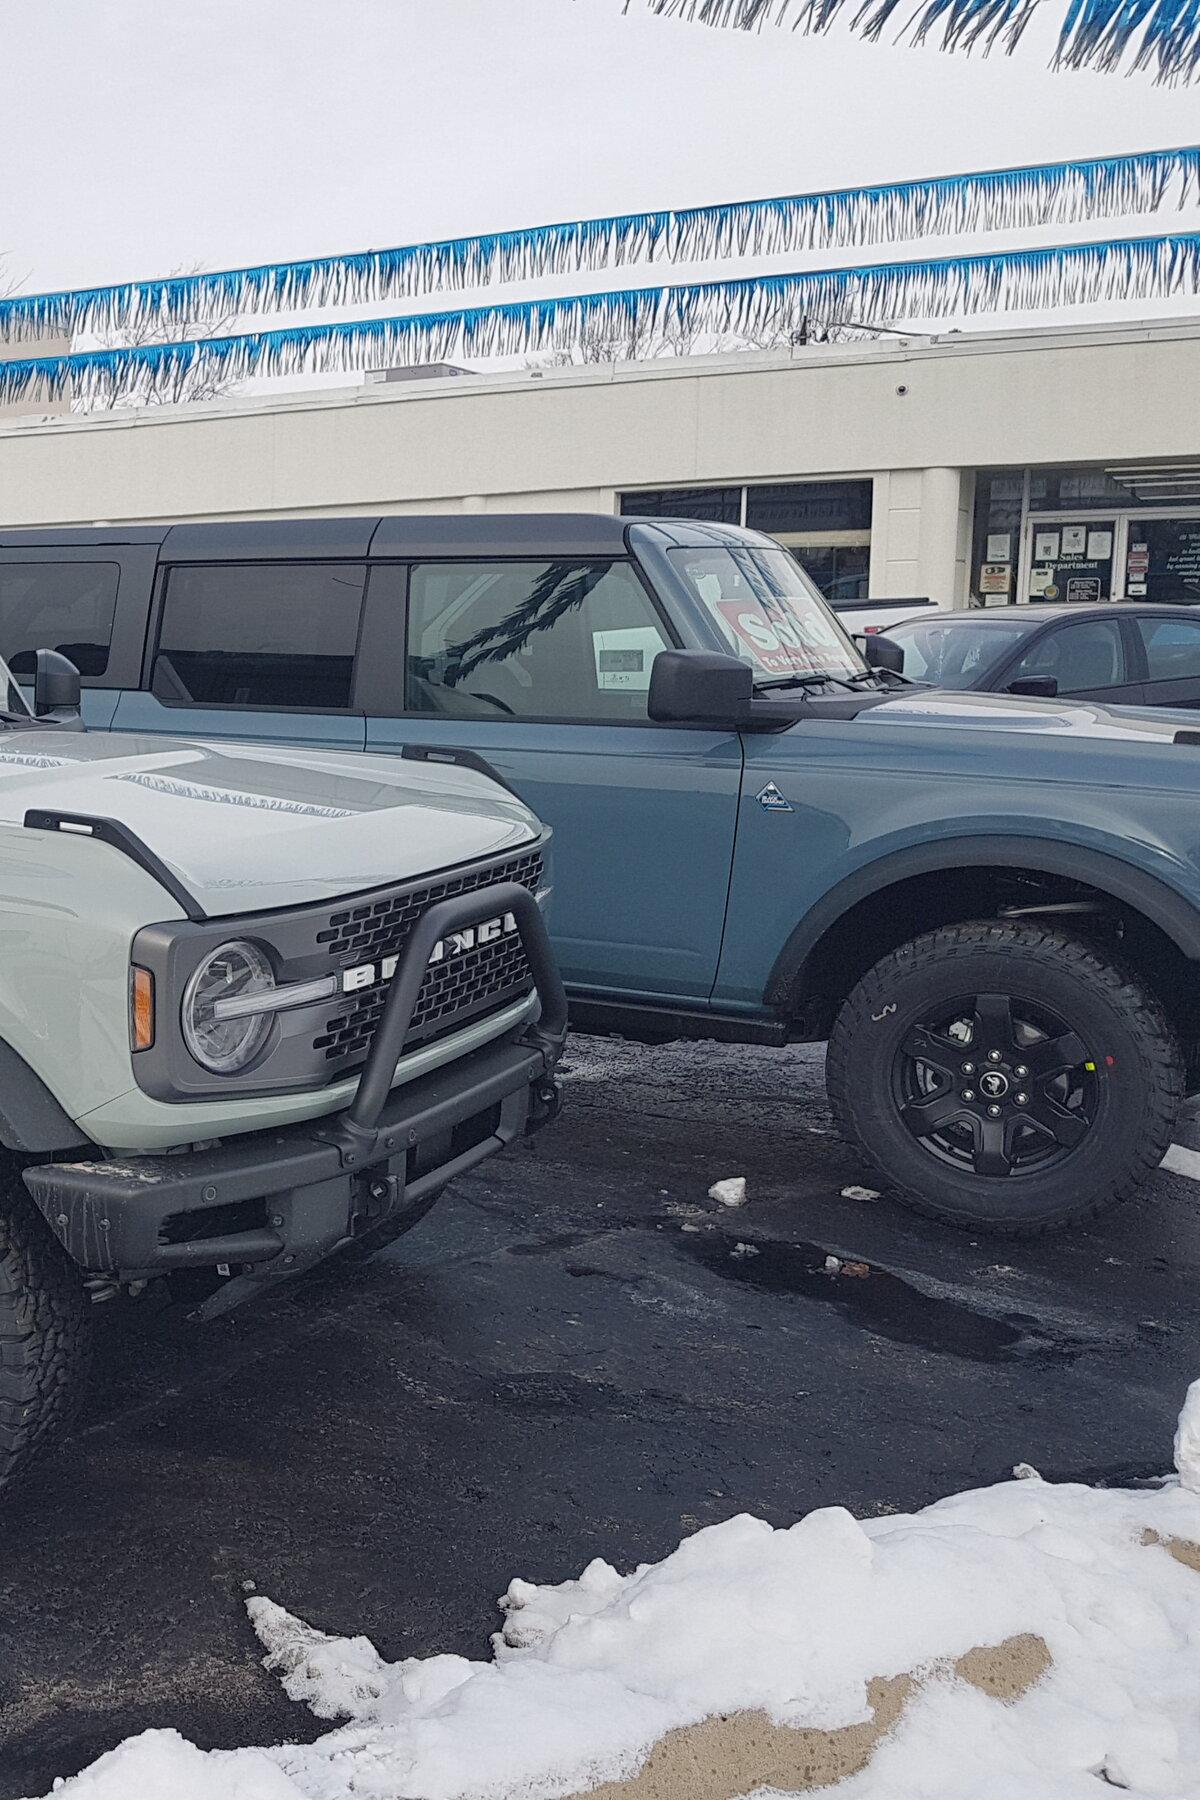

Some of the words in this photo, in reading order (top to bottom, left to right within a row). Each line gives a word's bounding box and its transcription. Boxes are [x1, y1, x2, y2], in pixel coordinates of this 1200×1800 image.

[1044, 561, 1098, 570] Department
[1059, 552, 1084, 561] Sales
[737, 612, 841, 651] Sold
[342, 911, 518, 993] BNC
